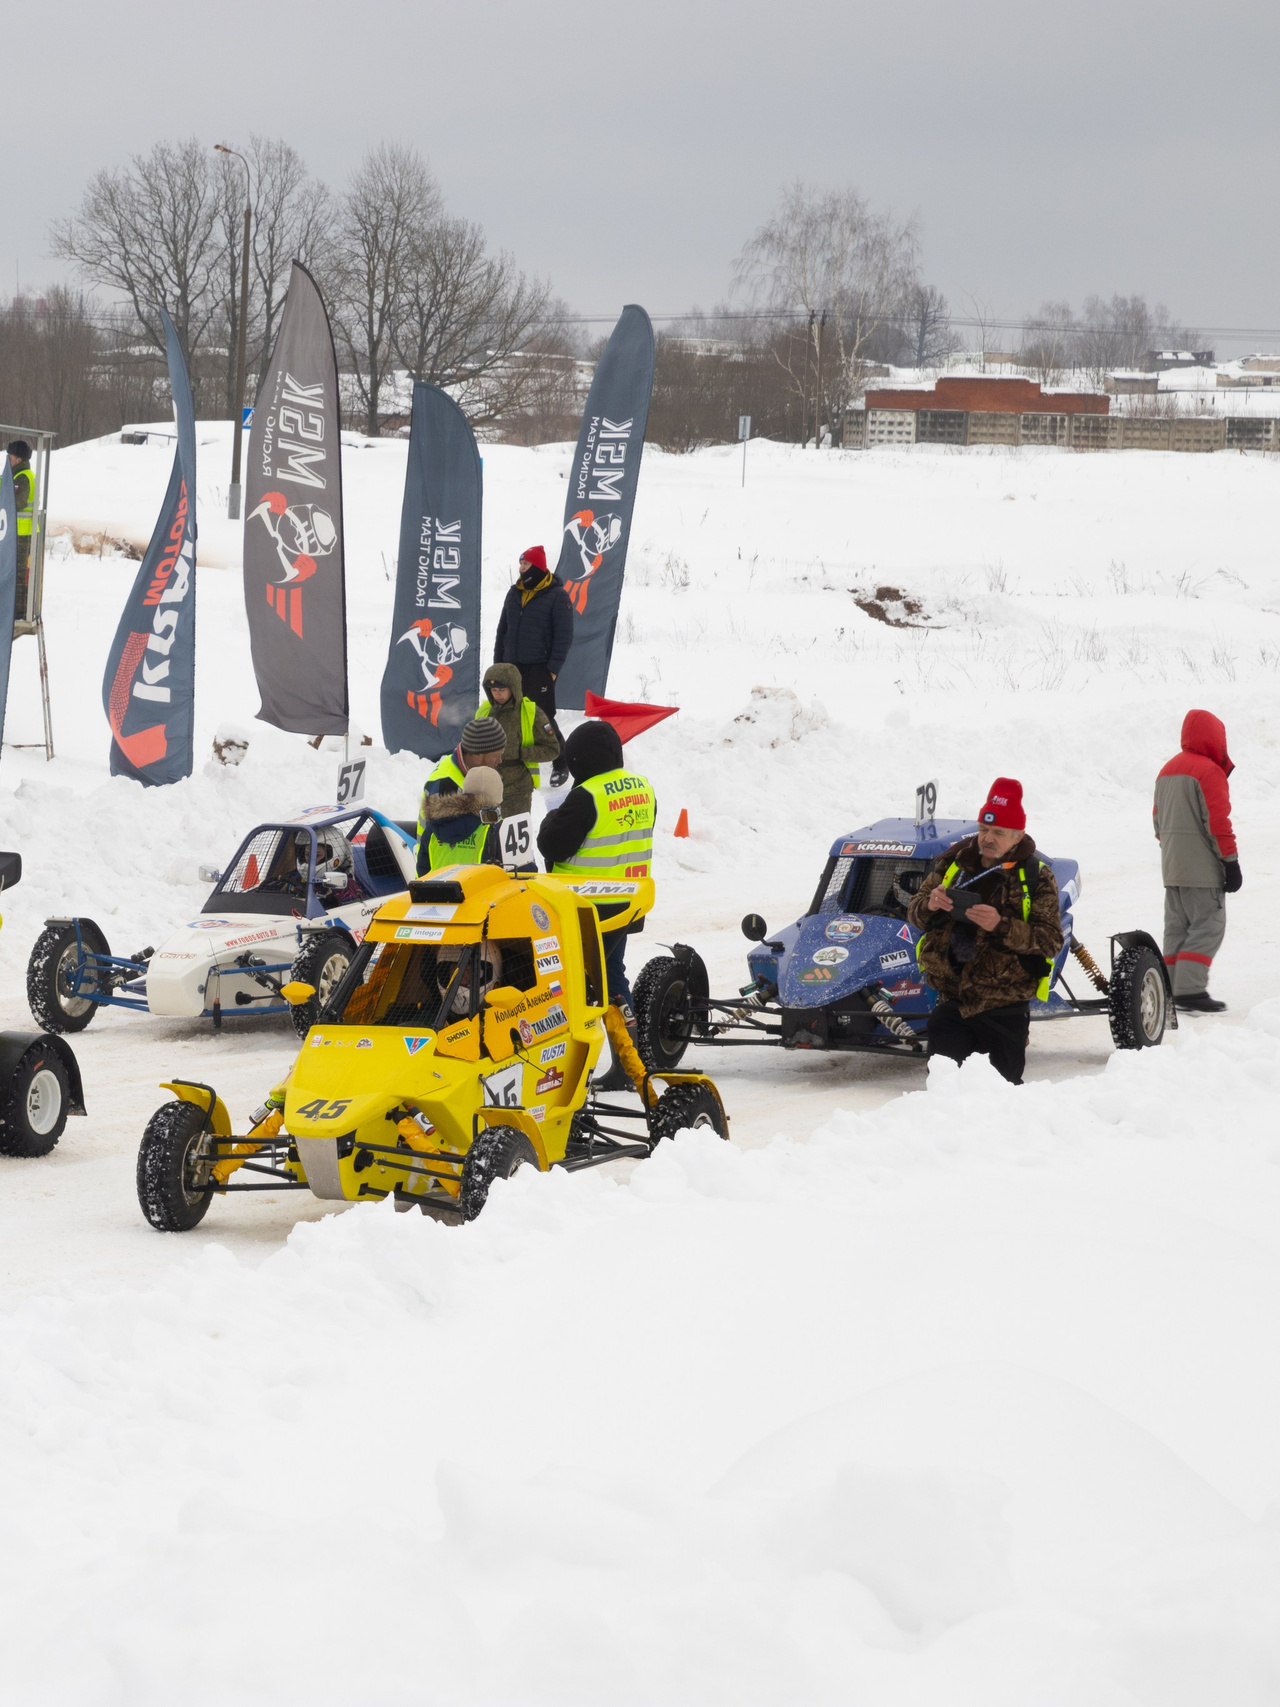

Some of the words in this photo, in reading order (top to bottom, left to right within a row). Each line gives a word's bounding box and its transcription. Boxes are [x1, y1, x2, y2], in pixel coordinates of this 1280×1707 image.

[336, 760, 366, 802] 57
[603, 777, 645, 796] RUSTA
[608, 793, 650, 812] МАРШАЛ
[916, 782, 937, 821] 79
[504, 820, 530, 857] 45
[857, 843, 914, 852] KRAMAR
[536, 955, 560, 968] NWB
[880, 951, 908, 964] NWB
[494, 1002, 527, 1024] Комаров
[526, 987, 555, 1012] Алексей
[531, 1010, 568, 1036] TAKAYAMA
[446, 1028, 471, 1043] SHONX
[540, 1042, 566, 1063] RUSTA
[296, 1098, 354, 1120] 45
